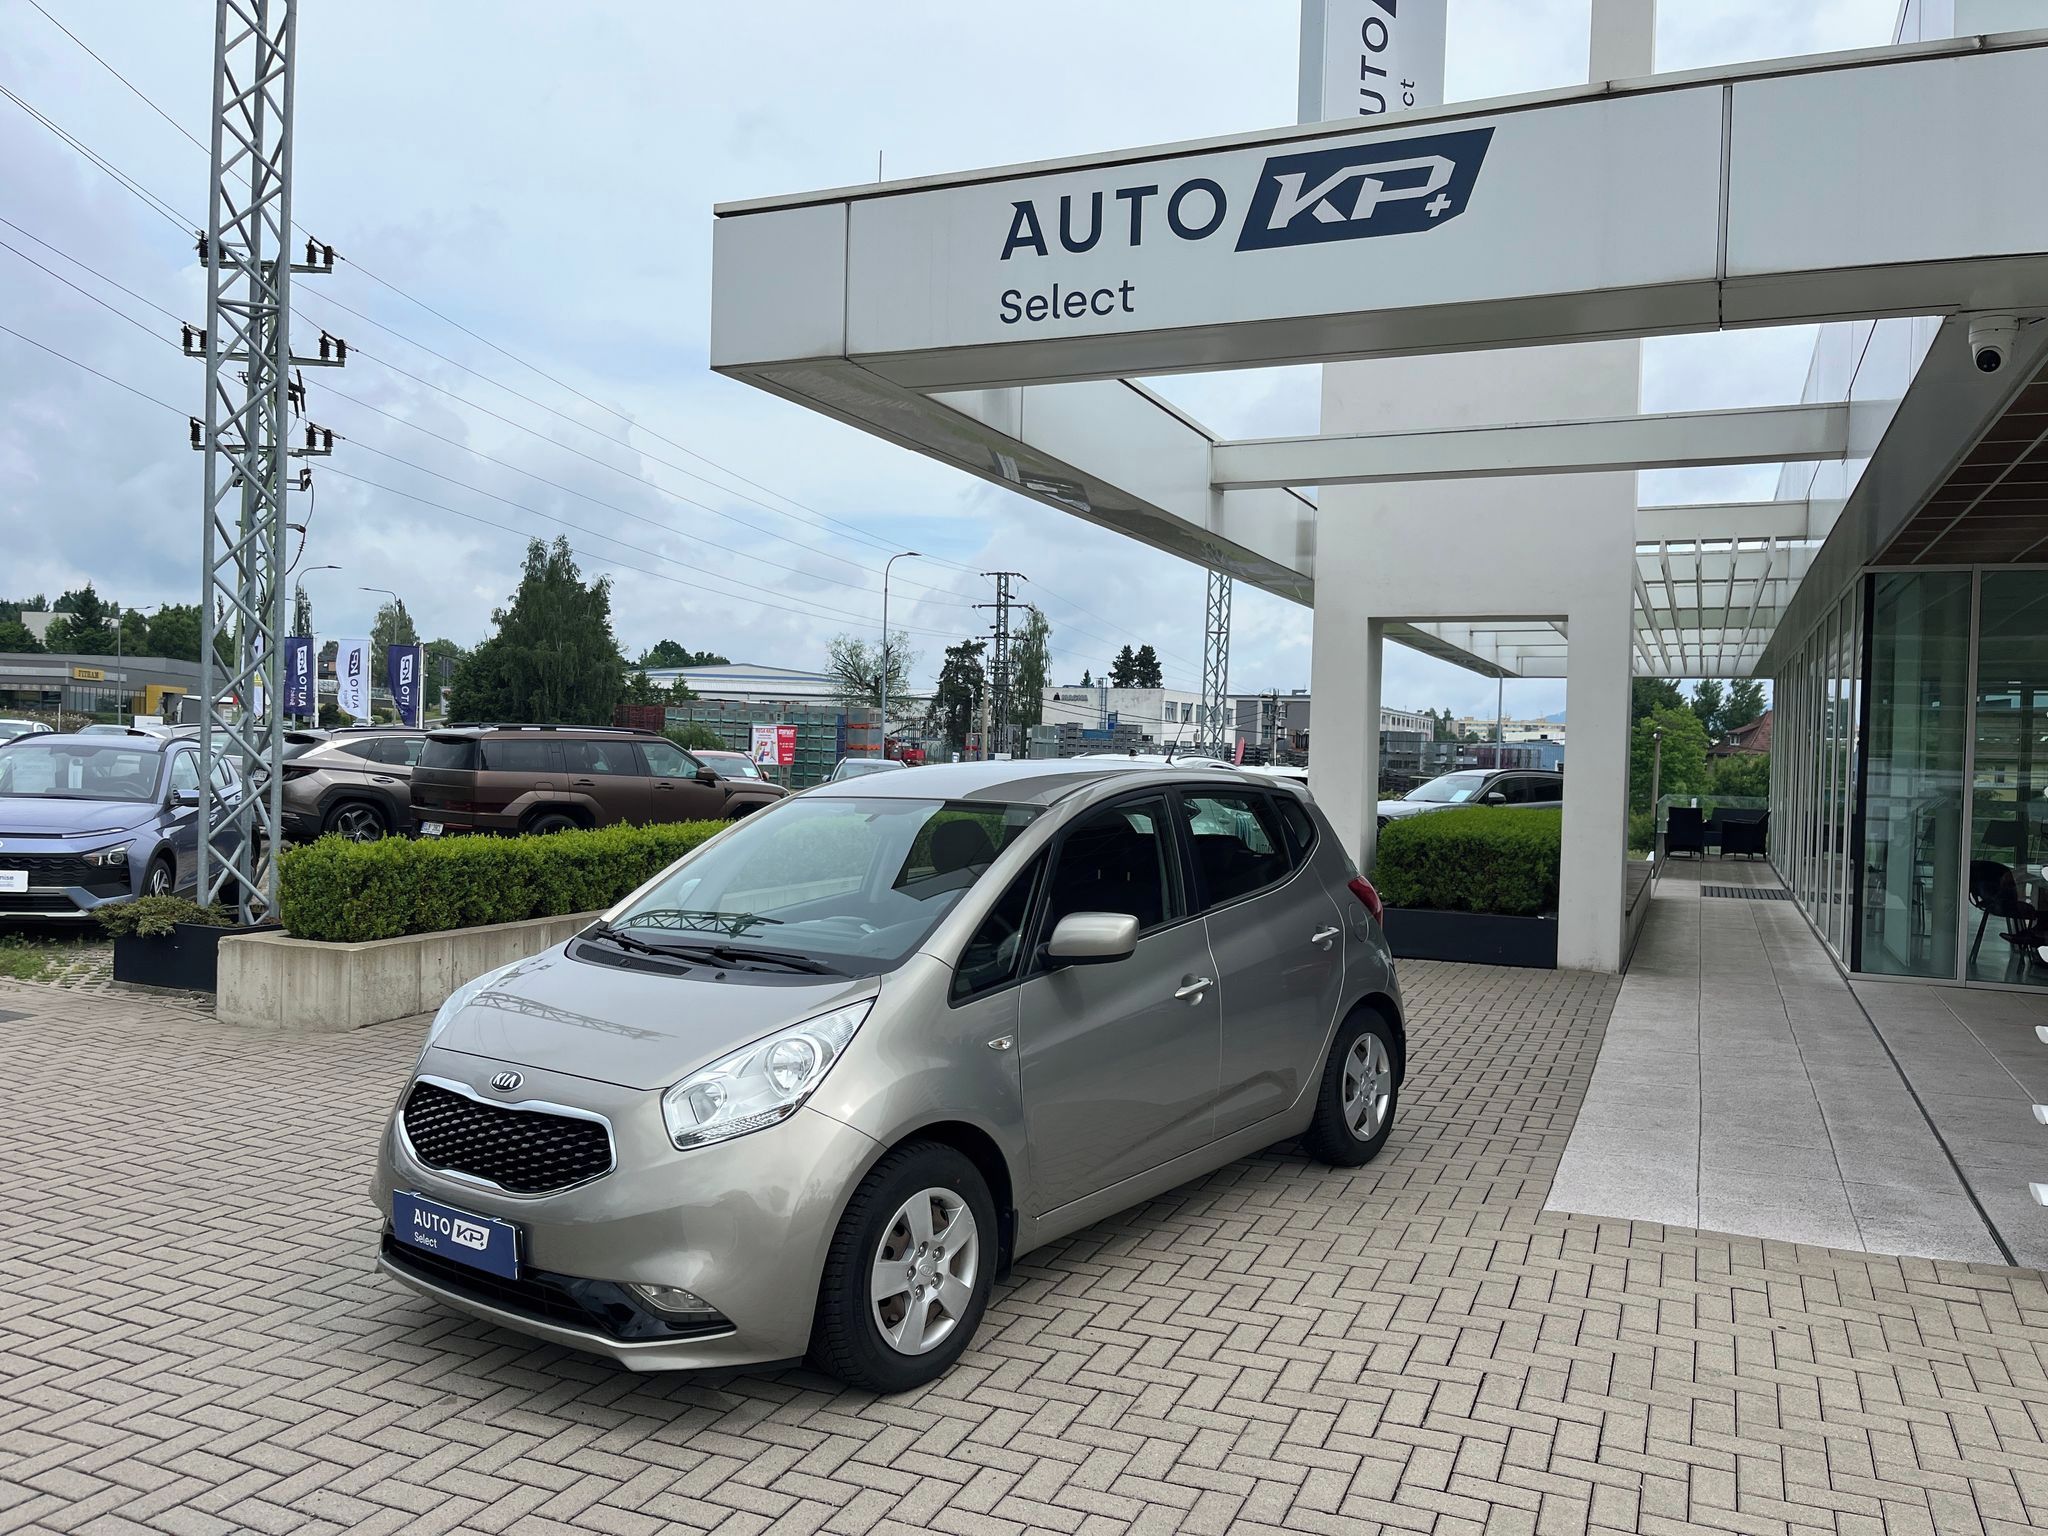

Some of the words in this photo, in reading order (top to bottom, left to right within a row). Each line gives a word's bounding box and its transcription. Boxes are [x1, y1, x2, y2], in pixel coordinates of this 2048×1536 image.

[1359, 16, 1389, 116] UTO
[1000, 178, 1227, 260] AUTO
[999, 280, 1136, 324] Select
[493, 1075, 517, 1088] KIA
[413, 1207, 451, 1236] AUTO
[414, 1230, 438, 1249] Select
